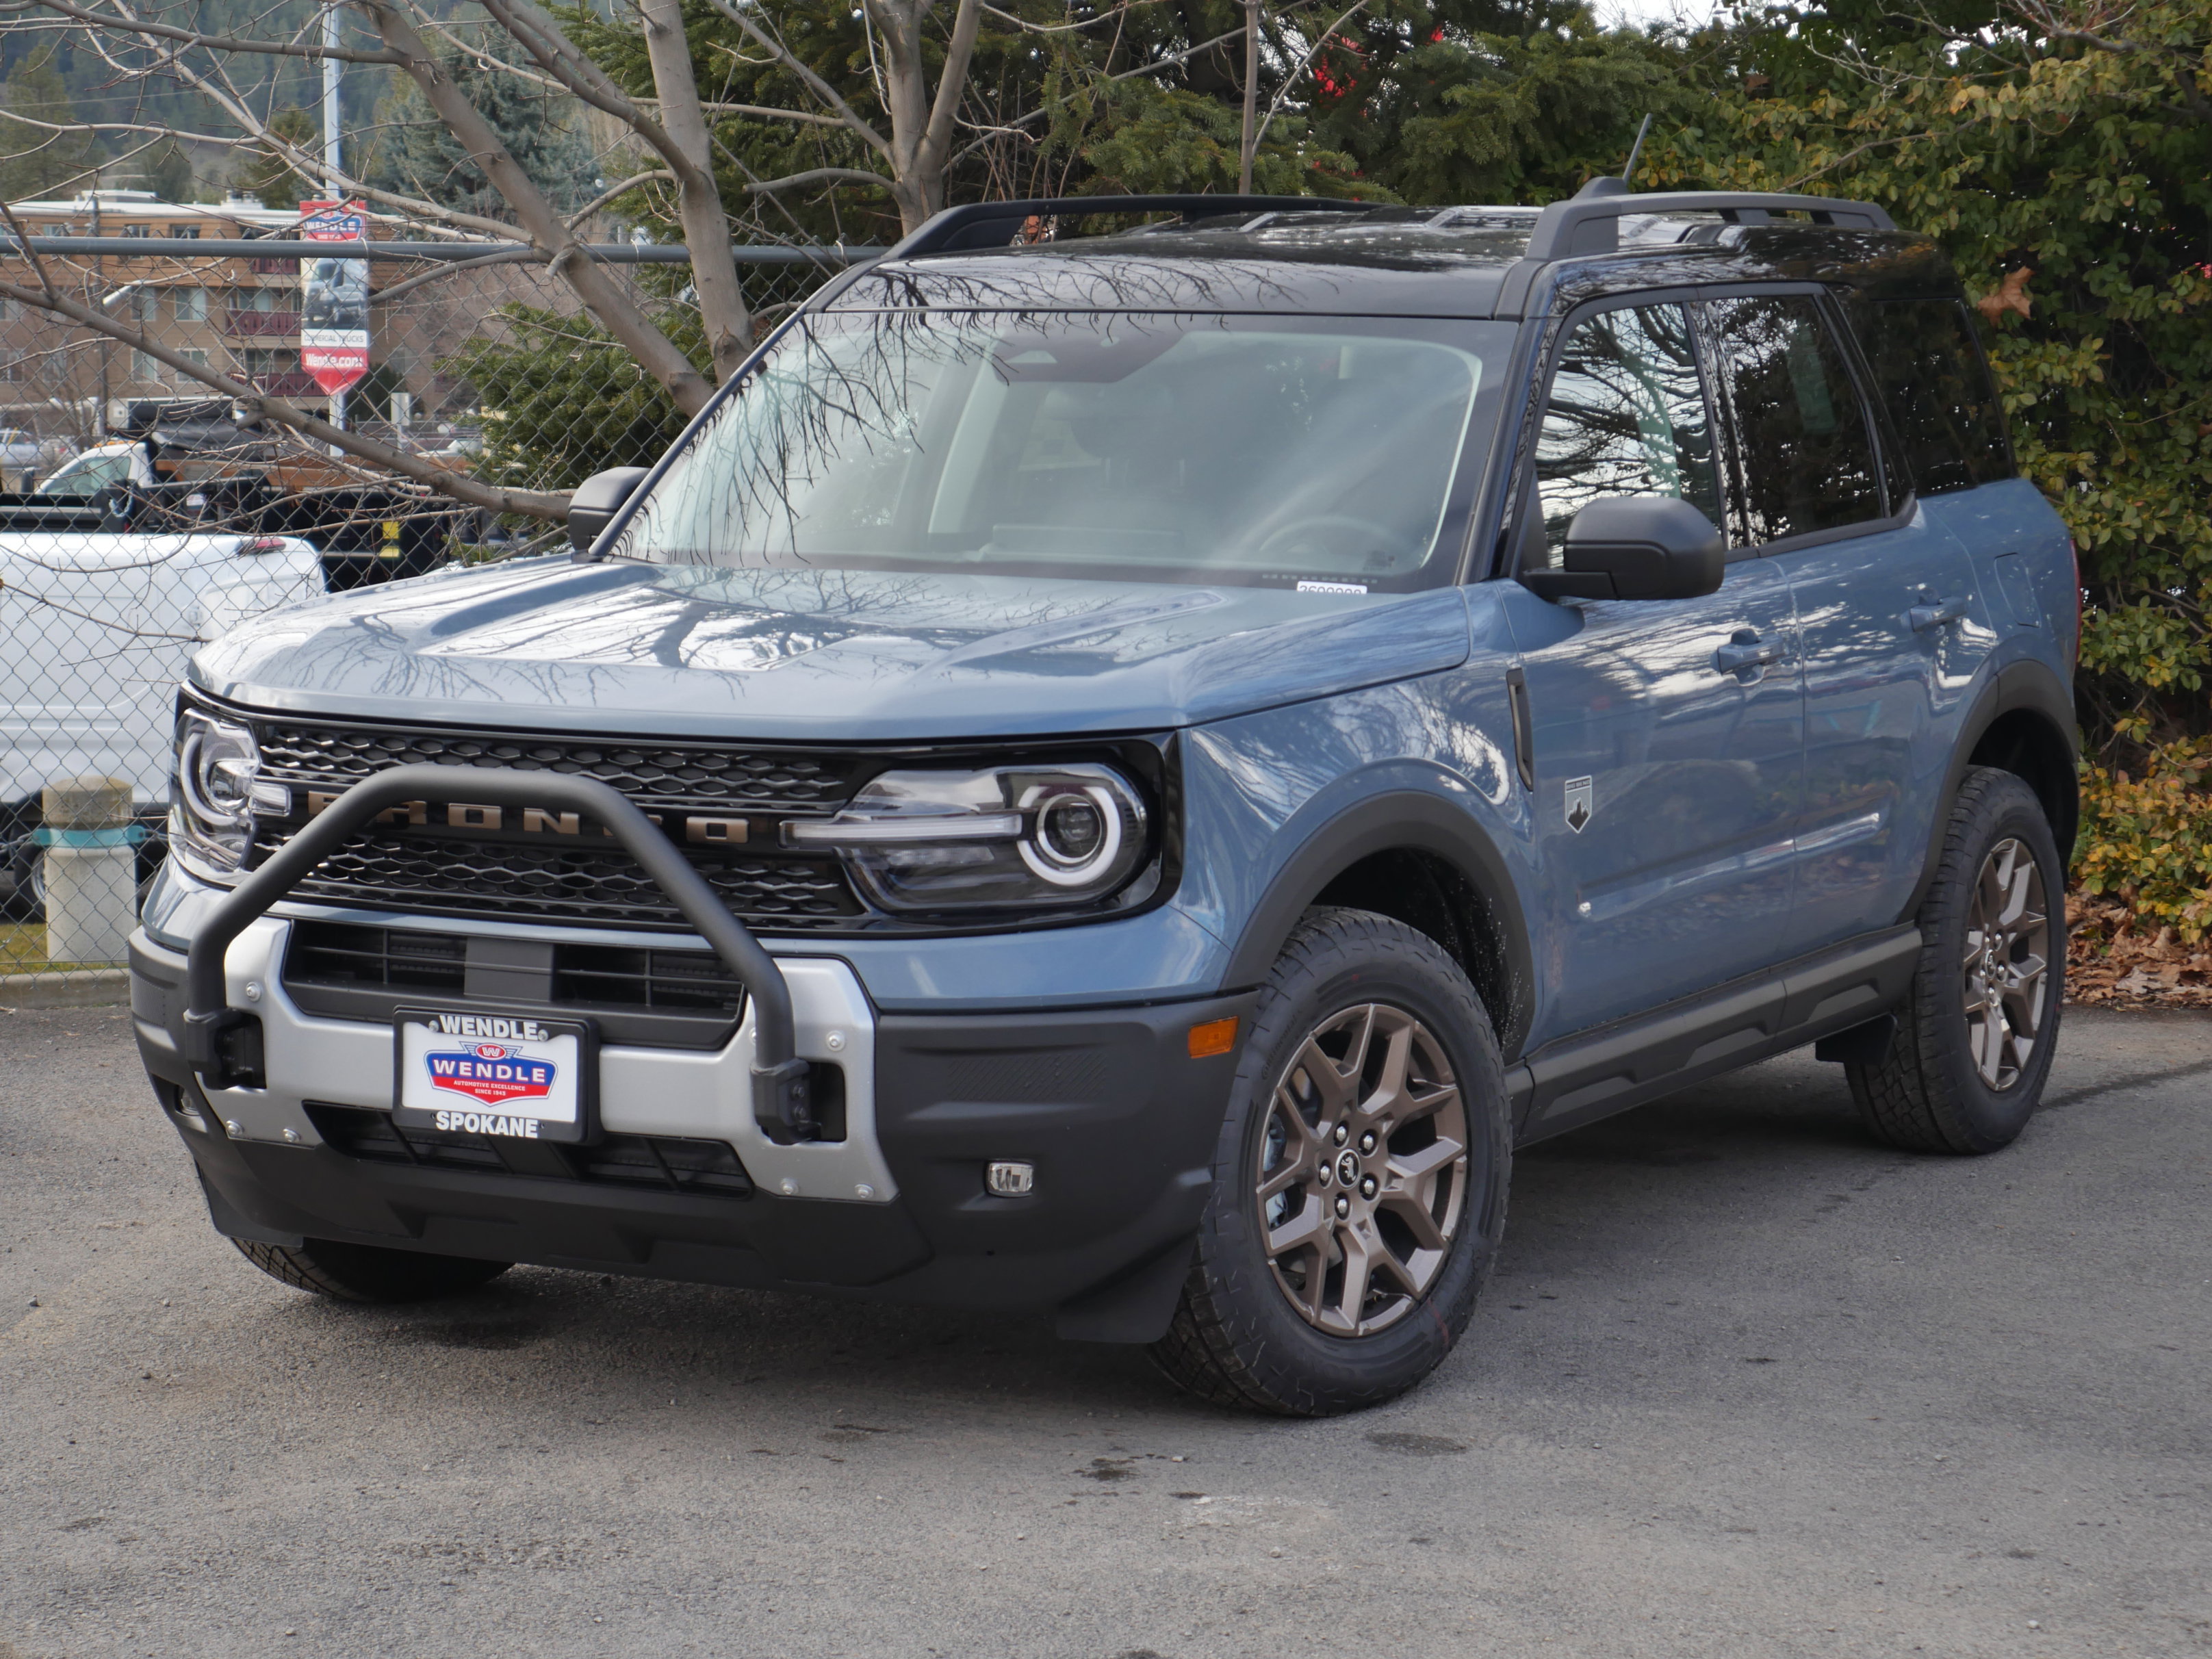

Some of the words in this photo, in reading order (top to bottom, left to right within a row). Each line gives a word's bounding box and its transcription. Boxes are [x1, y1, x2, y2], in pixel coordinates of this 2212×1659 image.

[308, 790, 749, 844] RONO
[439, 1015, 539, 1041] WENDLE
[433, 1059, 545, 1083] WENDLE
[454, 1080, 489, 1088] AUTOMOTIVE
[491, 1083, 526, 1092] EXCELLENCE
[435, 1111, 538, 1139] SPOKANE
